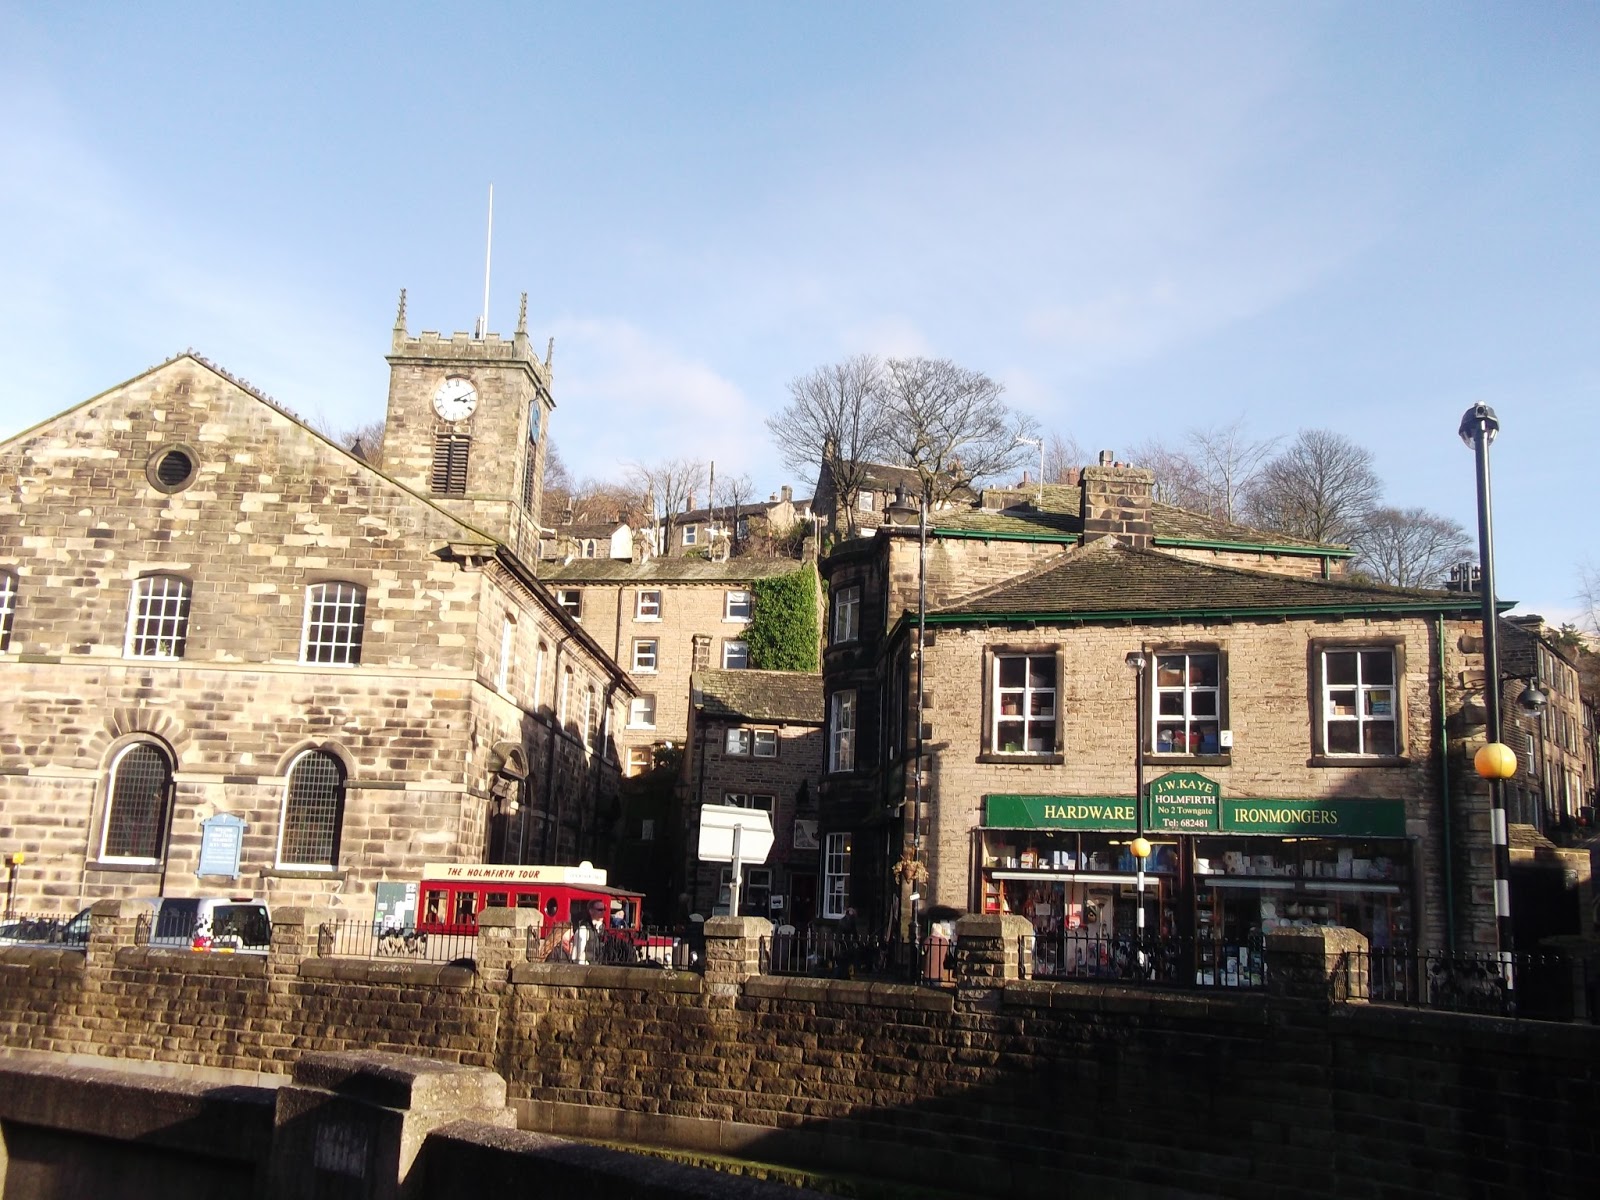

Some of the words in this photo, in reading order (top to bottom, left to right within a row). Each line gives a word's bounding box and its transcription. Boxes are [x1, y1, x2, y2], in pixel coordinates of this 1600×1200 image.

[1155, 795, 1216, 804] HOLMFIRTH
[1044, 805, 1135, 820] HARDWARE
[1158, 806, 1169, 814] No
[1177, 807, 1213, 816] Towngate
[1234, 808, 1338, 824] IRONMONGERS
[1162, 818, 1179, 827] Tel:
[1180, 819, 1208, 827] 682481
[447, 867, 463, 876] THE
[467, 868, 515, 878] HOLMFIRTH
[518, 870, 540, 878] TOUR
